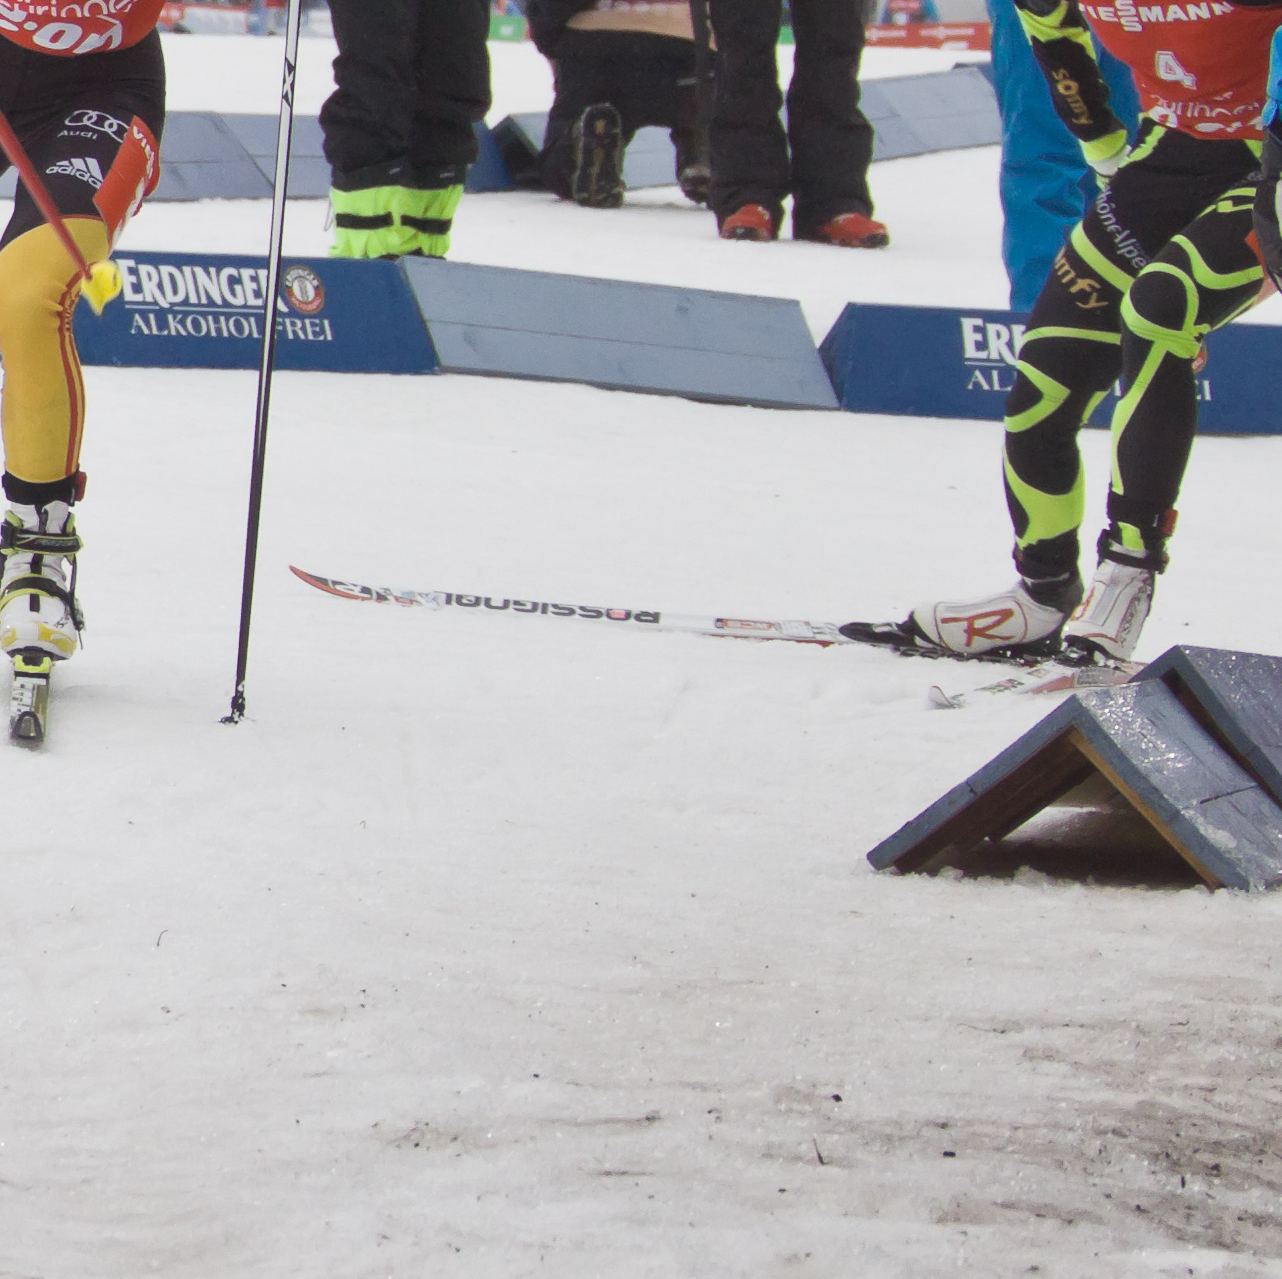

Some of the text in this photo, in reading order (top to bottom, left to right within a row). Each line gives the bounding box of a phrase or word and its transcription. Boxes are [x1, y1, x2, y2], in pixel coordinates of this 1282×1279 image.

[1083, 0, 1234, 32] IESSMANN
[1154, 50, 1198, 91] 4
[56, 129, 98, 140] Audi
[45, 166, 103, 190] adida
